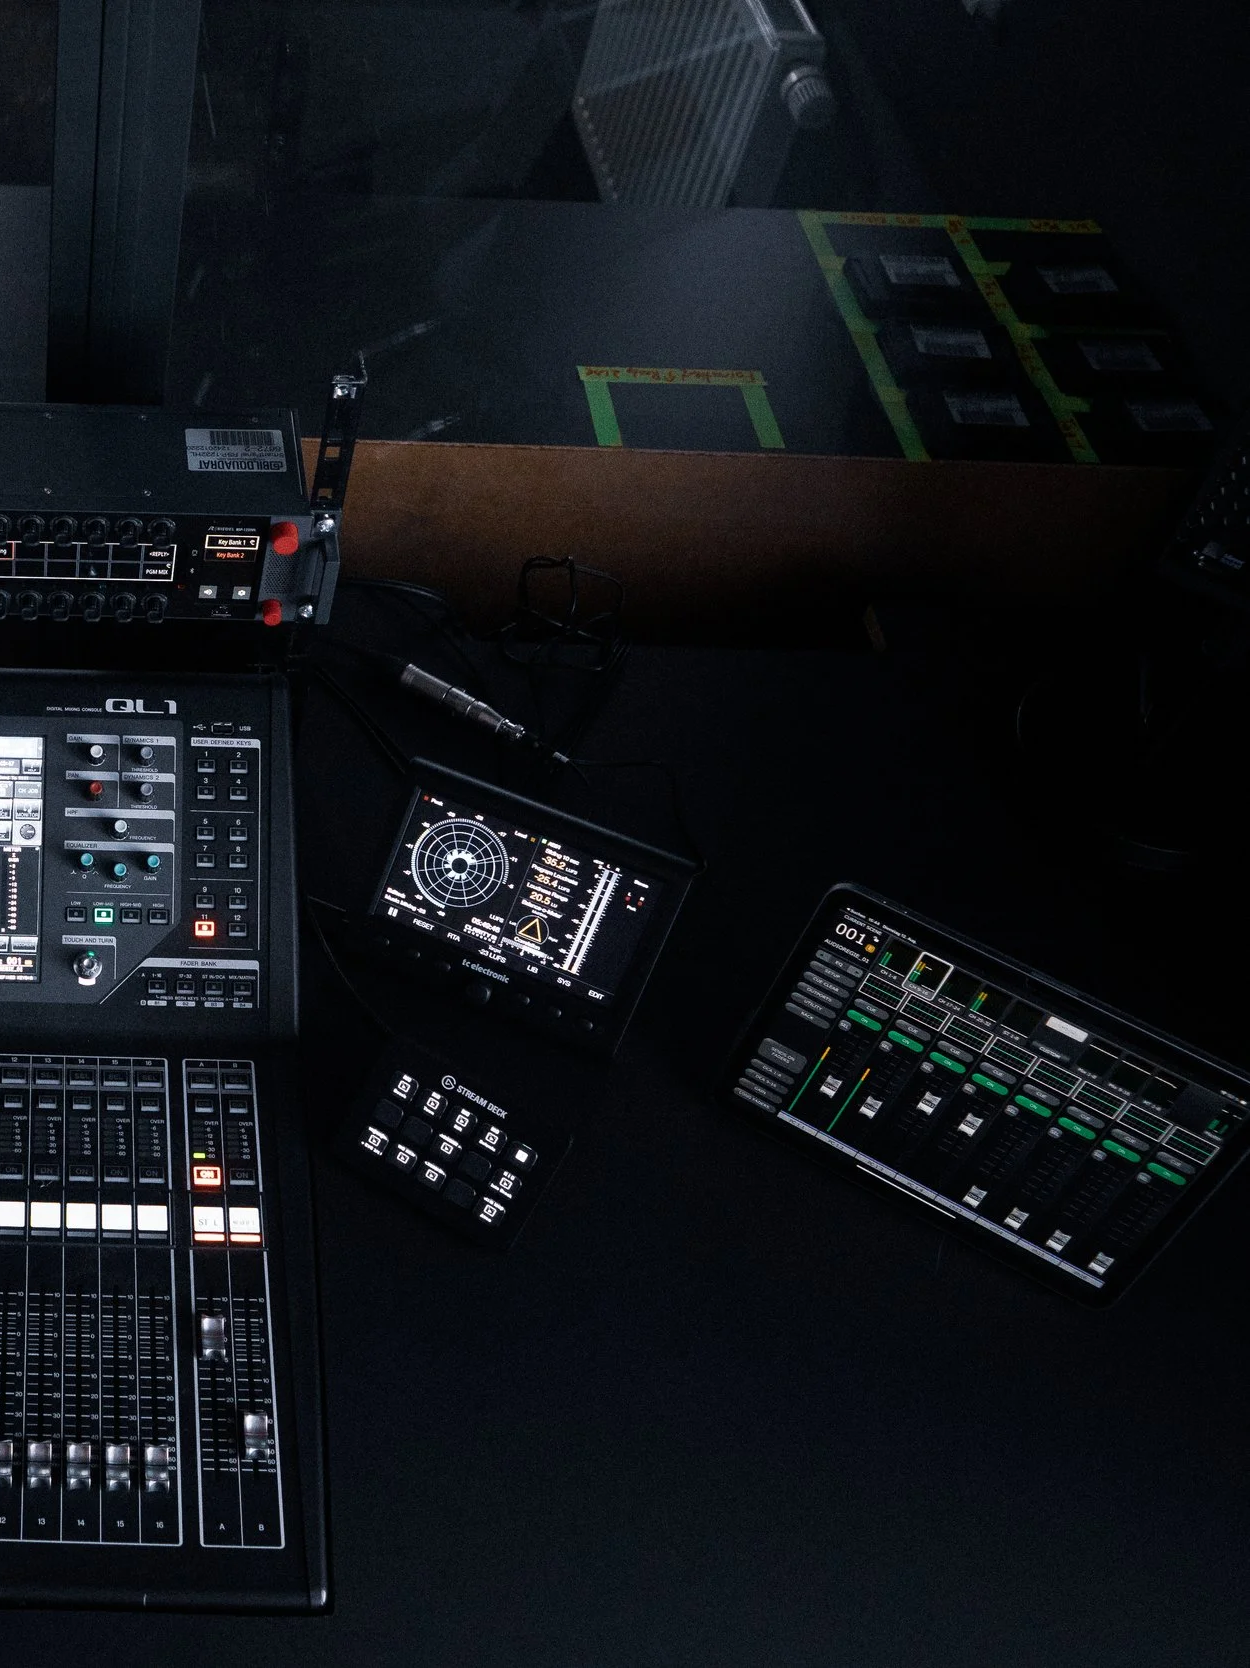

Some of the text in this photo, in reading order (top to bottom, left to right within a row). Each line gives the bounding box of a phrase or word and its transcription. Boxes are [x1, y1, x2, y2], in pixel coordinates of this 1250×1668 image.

[198, 460, 270, 470] BILDQUADRAT
[218, 539, 228, 547] Key
[216, 552, 226, 560] Key
[105, 698, 177, 714] QL1
[541, 856, 566, 870] -35.2
[534, 874, 559, 888] -25.4
[530, 891, 552, 906] 20.5
[412, 917, 435, 931] RESET
[843, 914, 883, 936] CURRENT SCENE
[447, 932, 461, 943] RTA
[835, 923, 867, 946] 001
[824, 938, 870, 964] AUDIOREGIE_01
[488, 953, 507, 965] LUFS
[462, 959, 510, 984] tc electronic
[526, 964, 539, 974] LIB
[556, 977, 572, 988] SYS
[588, 989, 605, 1001] EDIT
[456, 1084, 508, 1119] STREAM DECK
[200, 1169, 215, 1179] ON
[37, 1517, 46, 1526] 13
[77, 1519, 85, 1527] 14
[116, 1520, 125, 1528] 15
[155, 1521, 164, 1529] 16
[219, 1522, 226, 1530] A
[258, 1523, 265, 1532] B
